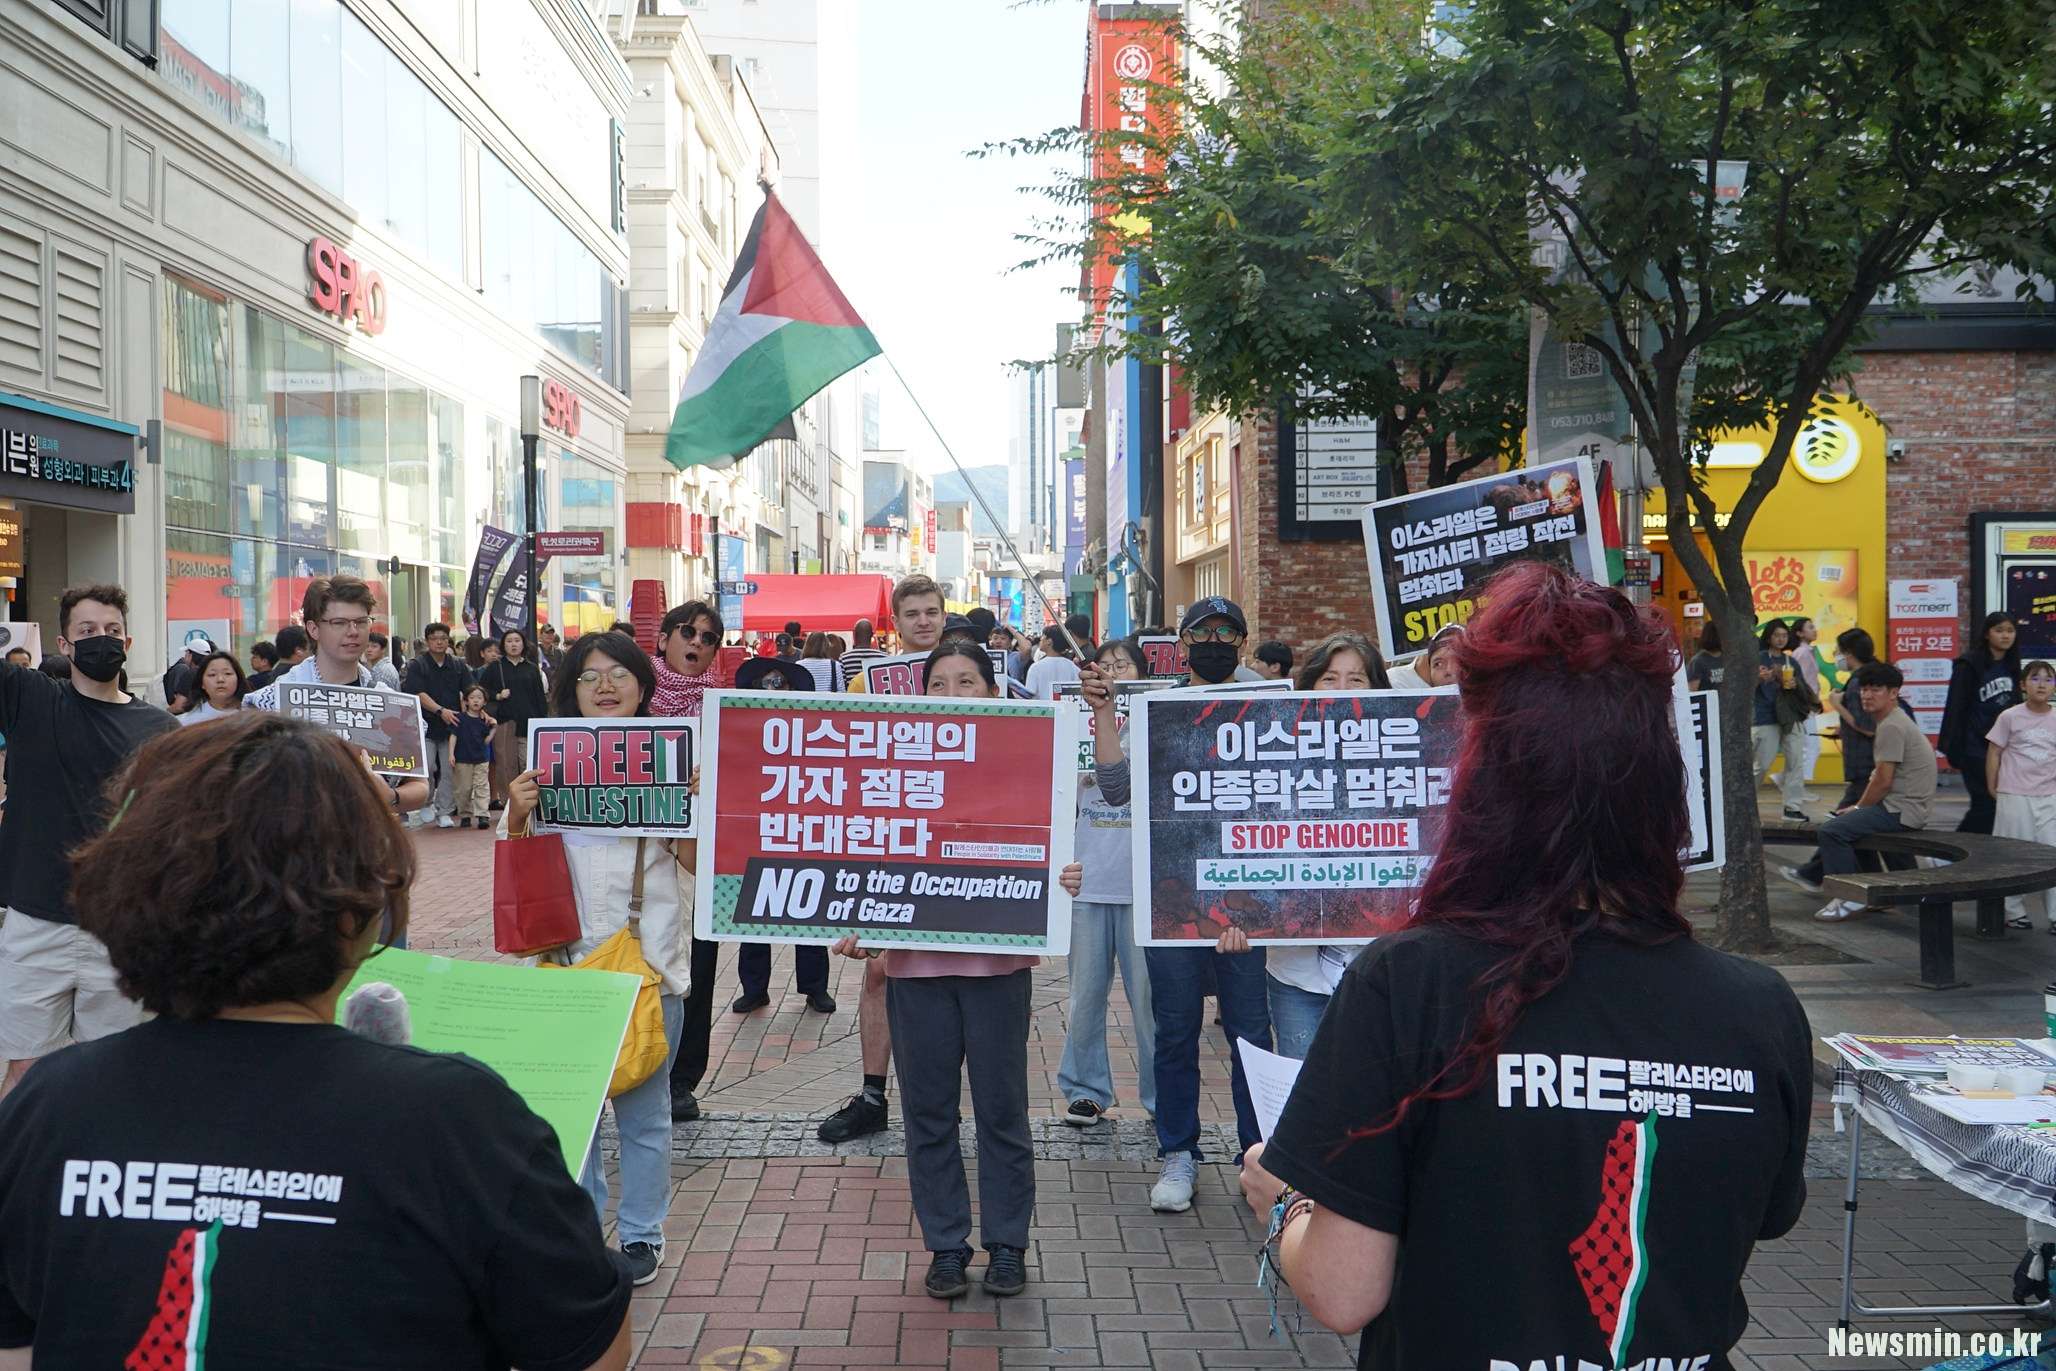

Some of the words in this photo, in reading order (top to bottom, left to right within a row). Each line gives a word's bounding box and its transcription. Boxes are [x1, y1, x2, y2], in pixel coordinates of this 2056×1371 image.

[306, 235, 386, 335] SPAO
[543, 378, 581, 438] SPAO
[29, 434, 40, 478] 의원
[44, 457, 84, 484] 성형외과
[91, 466, 120, 491] 피부과
[1390, 505, 1498, 550] 이스라엘은
[1394, 537, 1479, 576] 가자시티
[1484, 524, 1530, 557] 점령
[1532, 514, 1577, 543] 작전
[1399, 568, 1466, 604] 멈춰라
[1748, 555, 1805, 588] Let's
[1753, 584, 1801, 604] GO
[1404, 599, 1475, 642] STOP
[1143, 643, 1191, 674] FRE
[1896, 637, 1922, 652] 신규
[1925, 636, 1953, 652] 오픈
[289, 688, 385, 712] 이스라엘은
[334, 710, 374, 729] 학살
[538, 731, 653, 785] FREE
[762, 717, 976, 762] 이스라엘의
[1216, 718, 1420, 762] 이스라엘은
[540, 787, 688, 824] PALESTINE
[760, 765, 847, 806] 가자
[860, 768, 945, 809] 점령
[1172, 768, 1337, 812] 인종학살
[759, 812, 932, 857] 반대한다
[1231, 823, 1290, 850] STOP
[1296, 822, 1408, 849] GENOCIDE
[751, 867, 825, 920] NO
[836, 868, 858, 893] to
[866, 870, 903, 895] the
[911, 871, 1043, 901] Occupation
[1203, 862, 1294, 884] الجماعية
[826, 898, 853, 921] of
[858, 898, 915, 923] Gaza
[1497, 1053, 1627, 1112] FREE
[1628, 1059, 1754, 1093] 팔레스타인에
[1627, 1088, 1691, 1118] 해방을
[59, 1159, 199, 1221] FREE
[198, 1165, 343, 1202] 팔레스타인에
[193, 1195, 261, 1229] 해방을
